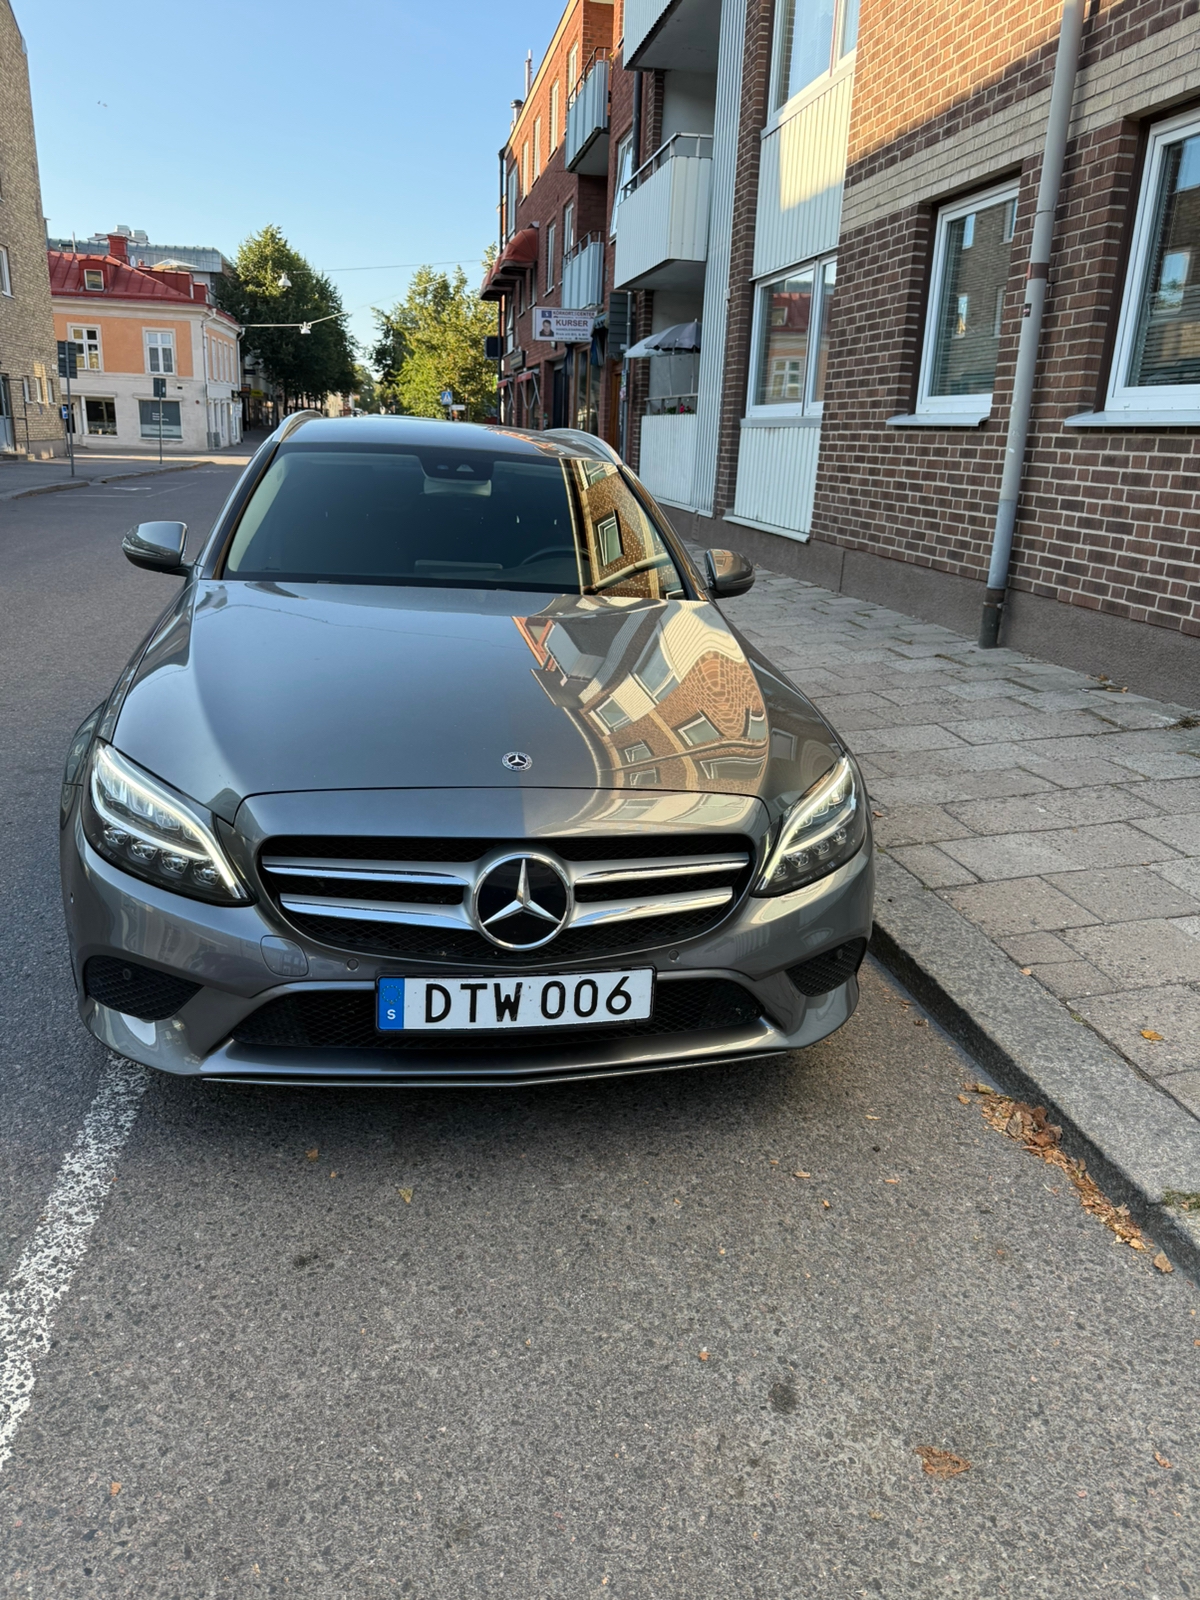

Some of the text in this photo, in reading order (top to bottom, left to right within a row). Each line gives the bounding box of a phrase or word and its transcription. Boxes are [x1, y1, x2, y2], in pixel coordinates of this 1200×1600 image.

[425, 976, 632, 1023] DTW 006
[387, 1009, 396, 1020] S
